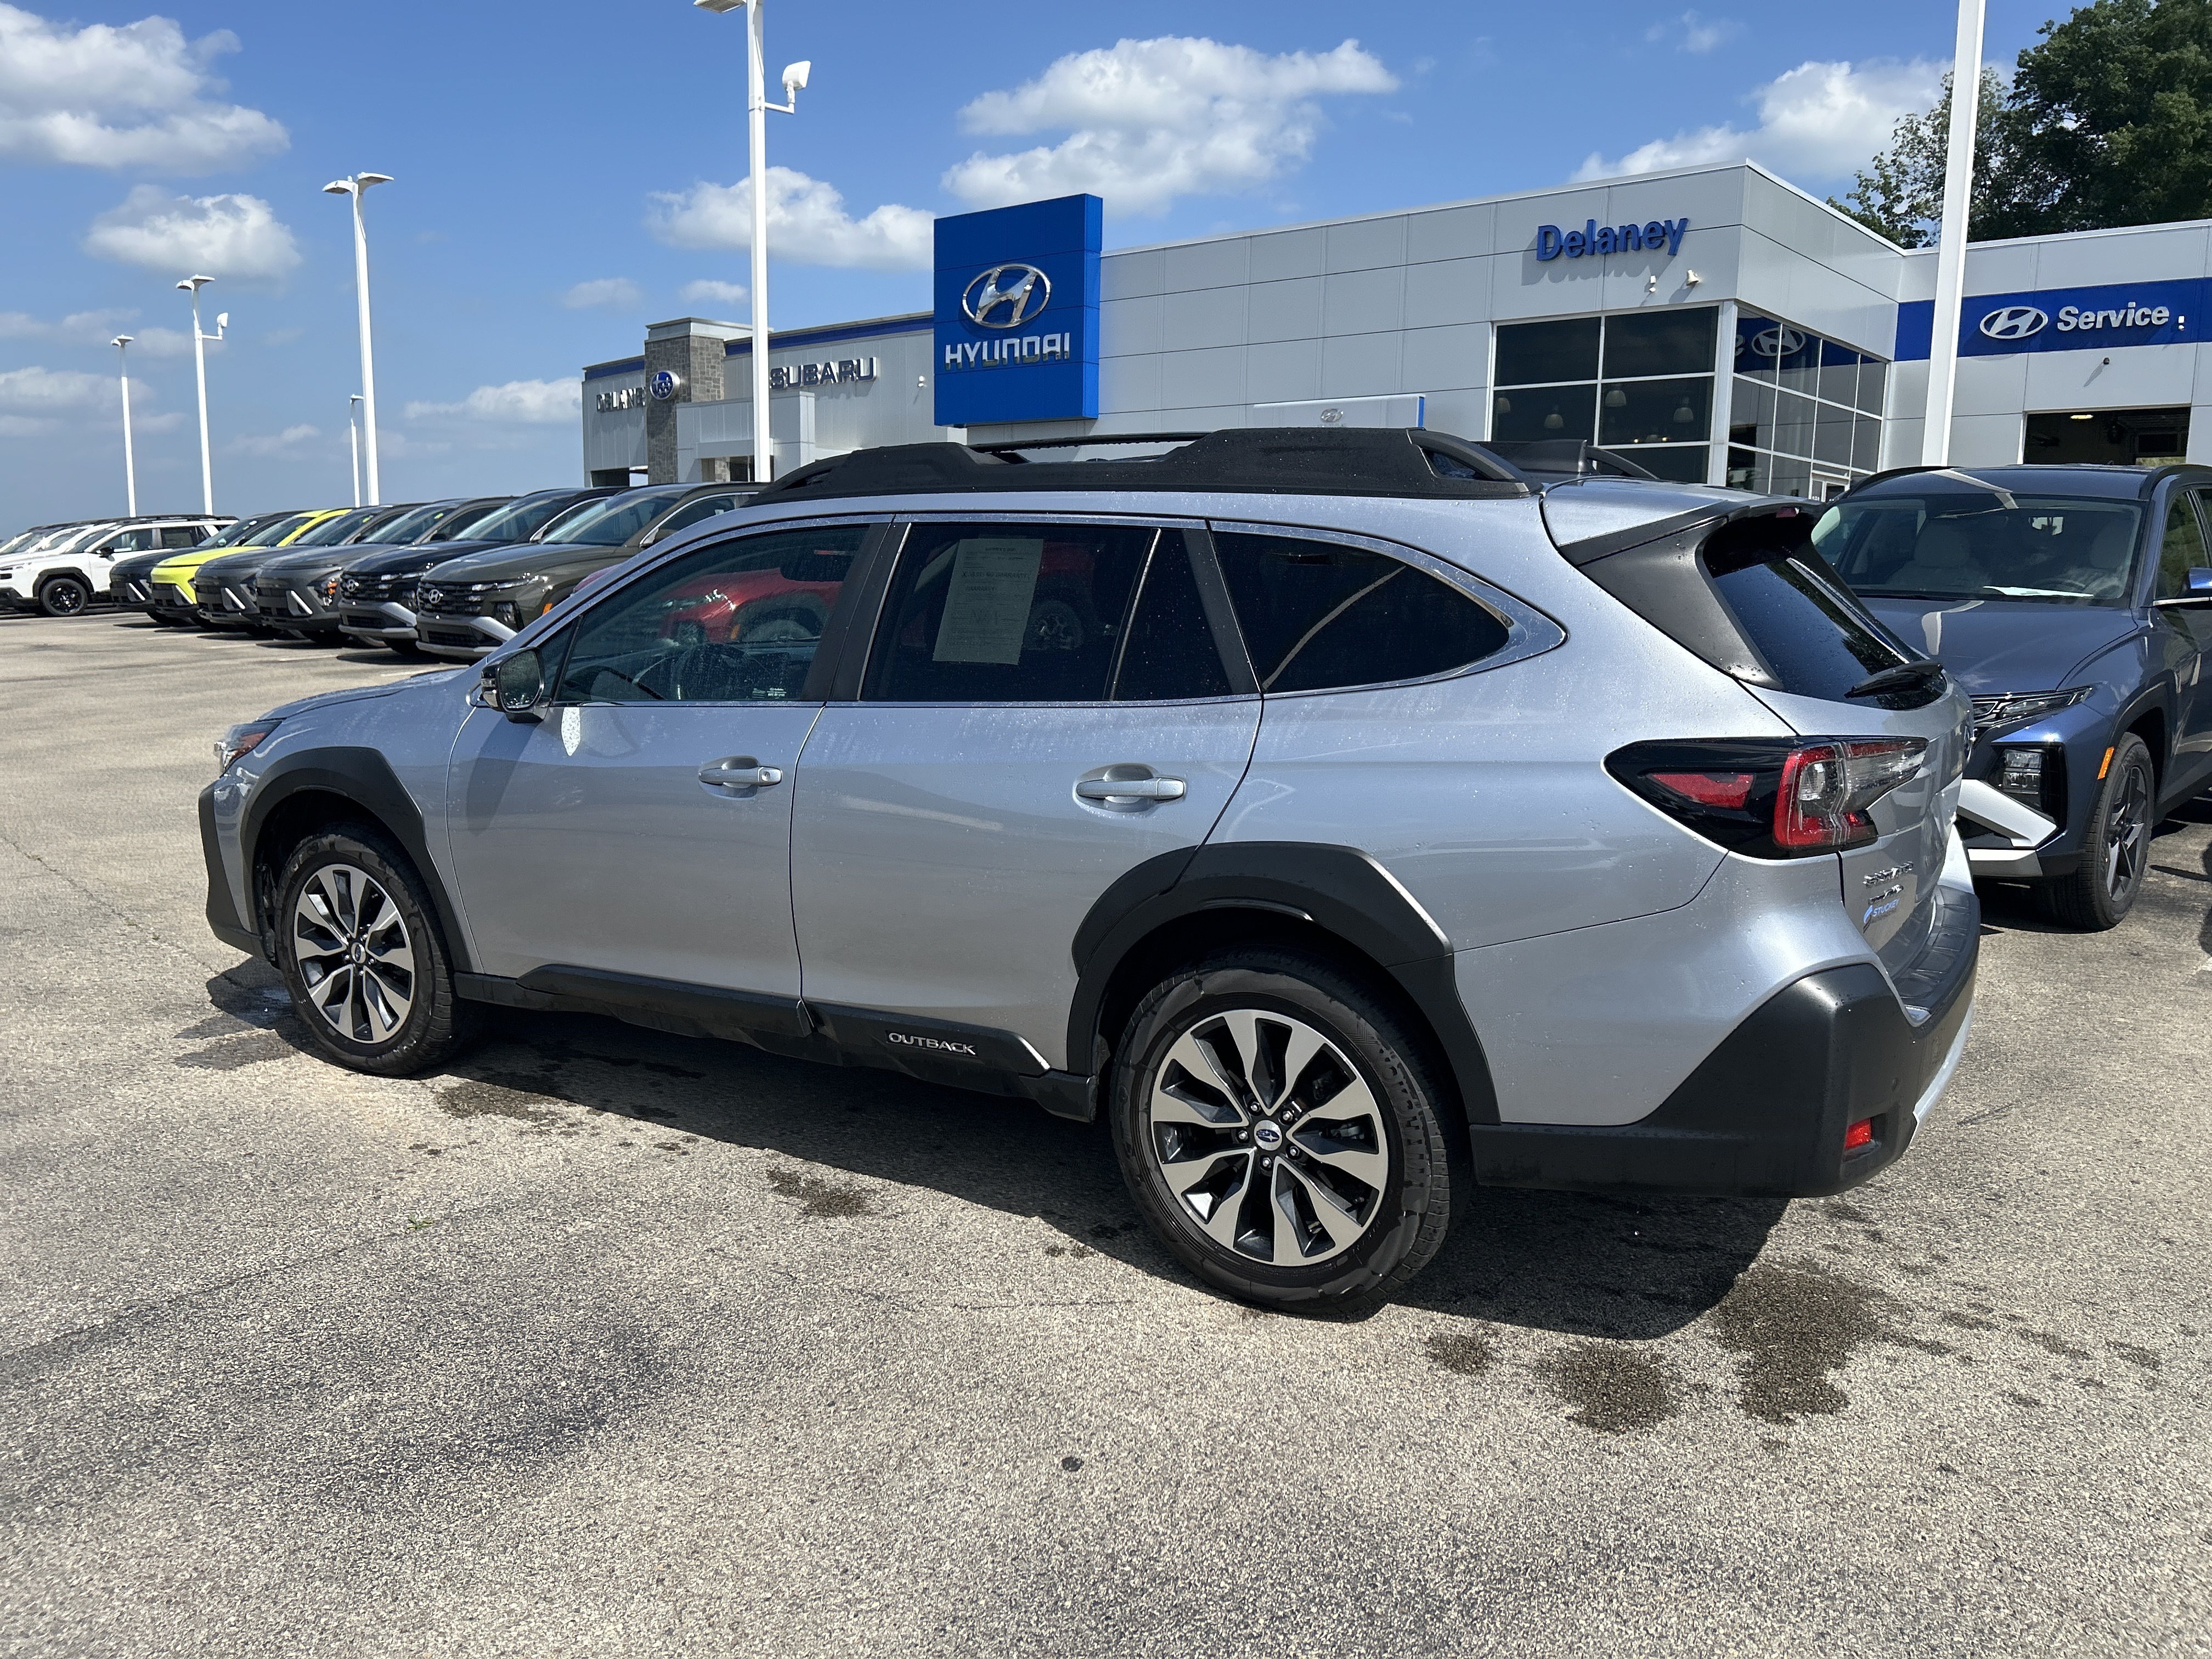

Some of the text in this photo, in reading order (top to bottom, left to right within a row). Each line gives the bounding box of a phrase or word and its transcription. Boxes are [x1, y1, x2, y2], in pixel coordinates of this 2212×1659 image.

[1536, 218, 1689, 261] Delaney
[2057, 302, 2169, 331] Service
[945, 332, 1070, 370] HYUNDAI
[769, 357, 877, 390] SUBARU
[888, 1032, 976, 1055] OUTBACK
